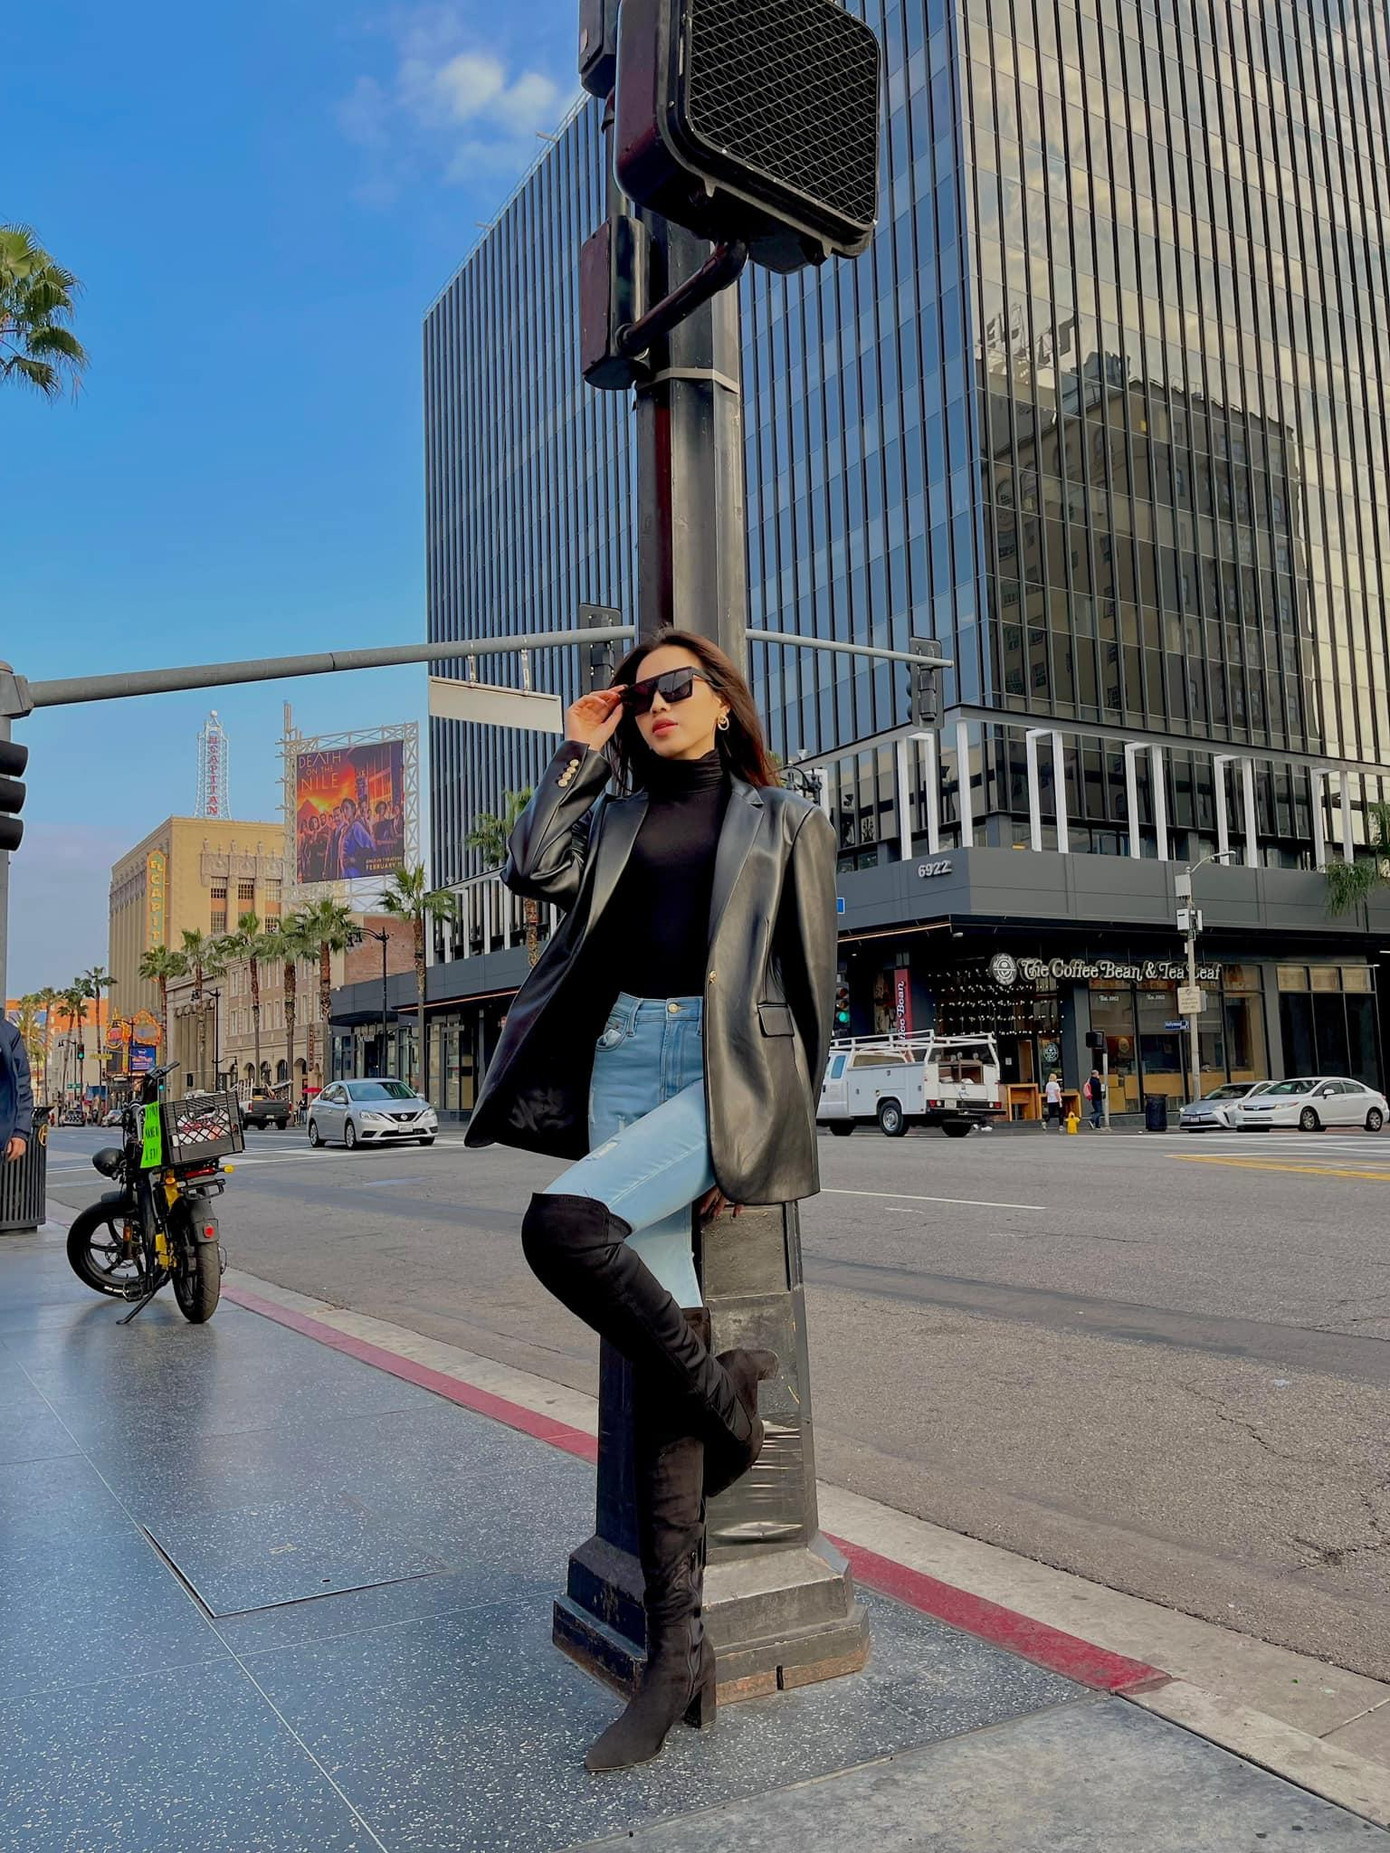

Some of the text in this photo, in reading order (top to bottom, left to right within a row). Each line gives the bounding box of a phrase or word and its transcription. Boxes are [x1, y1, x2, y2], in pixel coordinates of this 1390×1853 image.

[299, 752, 341, 769] DEATH
[208, 745, 218, 816] CAPITAN
[306, 765, 334, 777] ON THE
[301, 773, 339, 792] NILE
[918, 860, 952, 877] 6922
[1021, 960, 1049, 980] The
[1052, 960, 1099, 978] Coffee
[1101, 961, 1143, 982] Bean
[1145, 962, 1157, 979] &
[1159, 962, 1185, 980] Tea
[896, 981, 905, 1018] Bean
